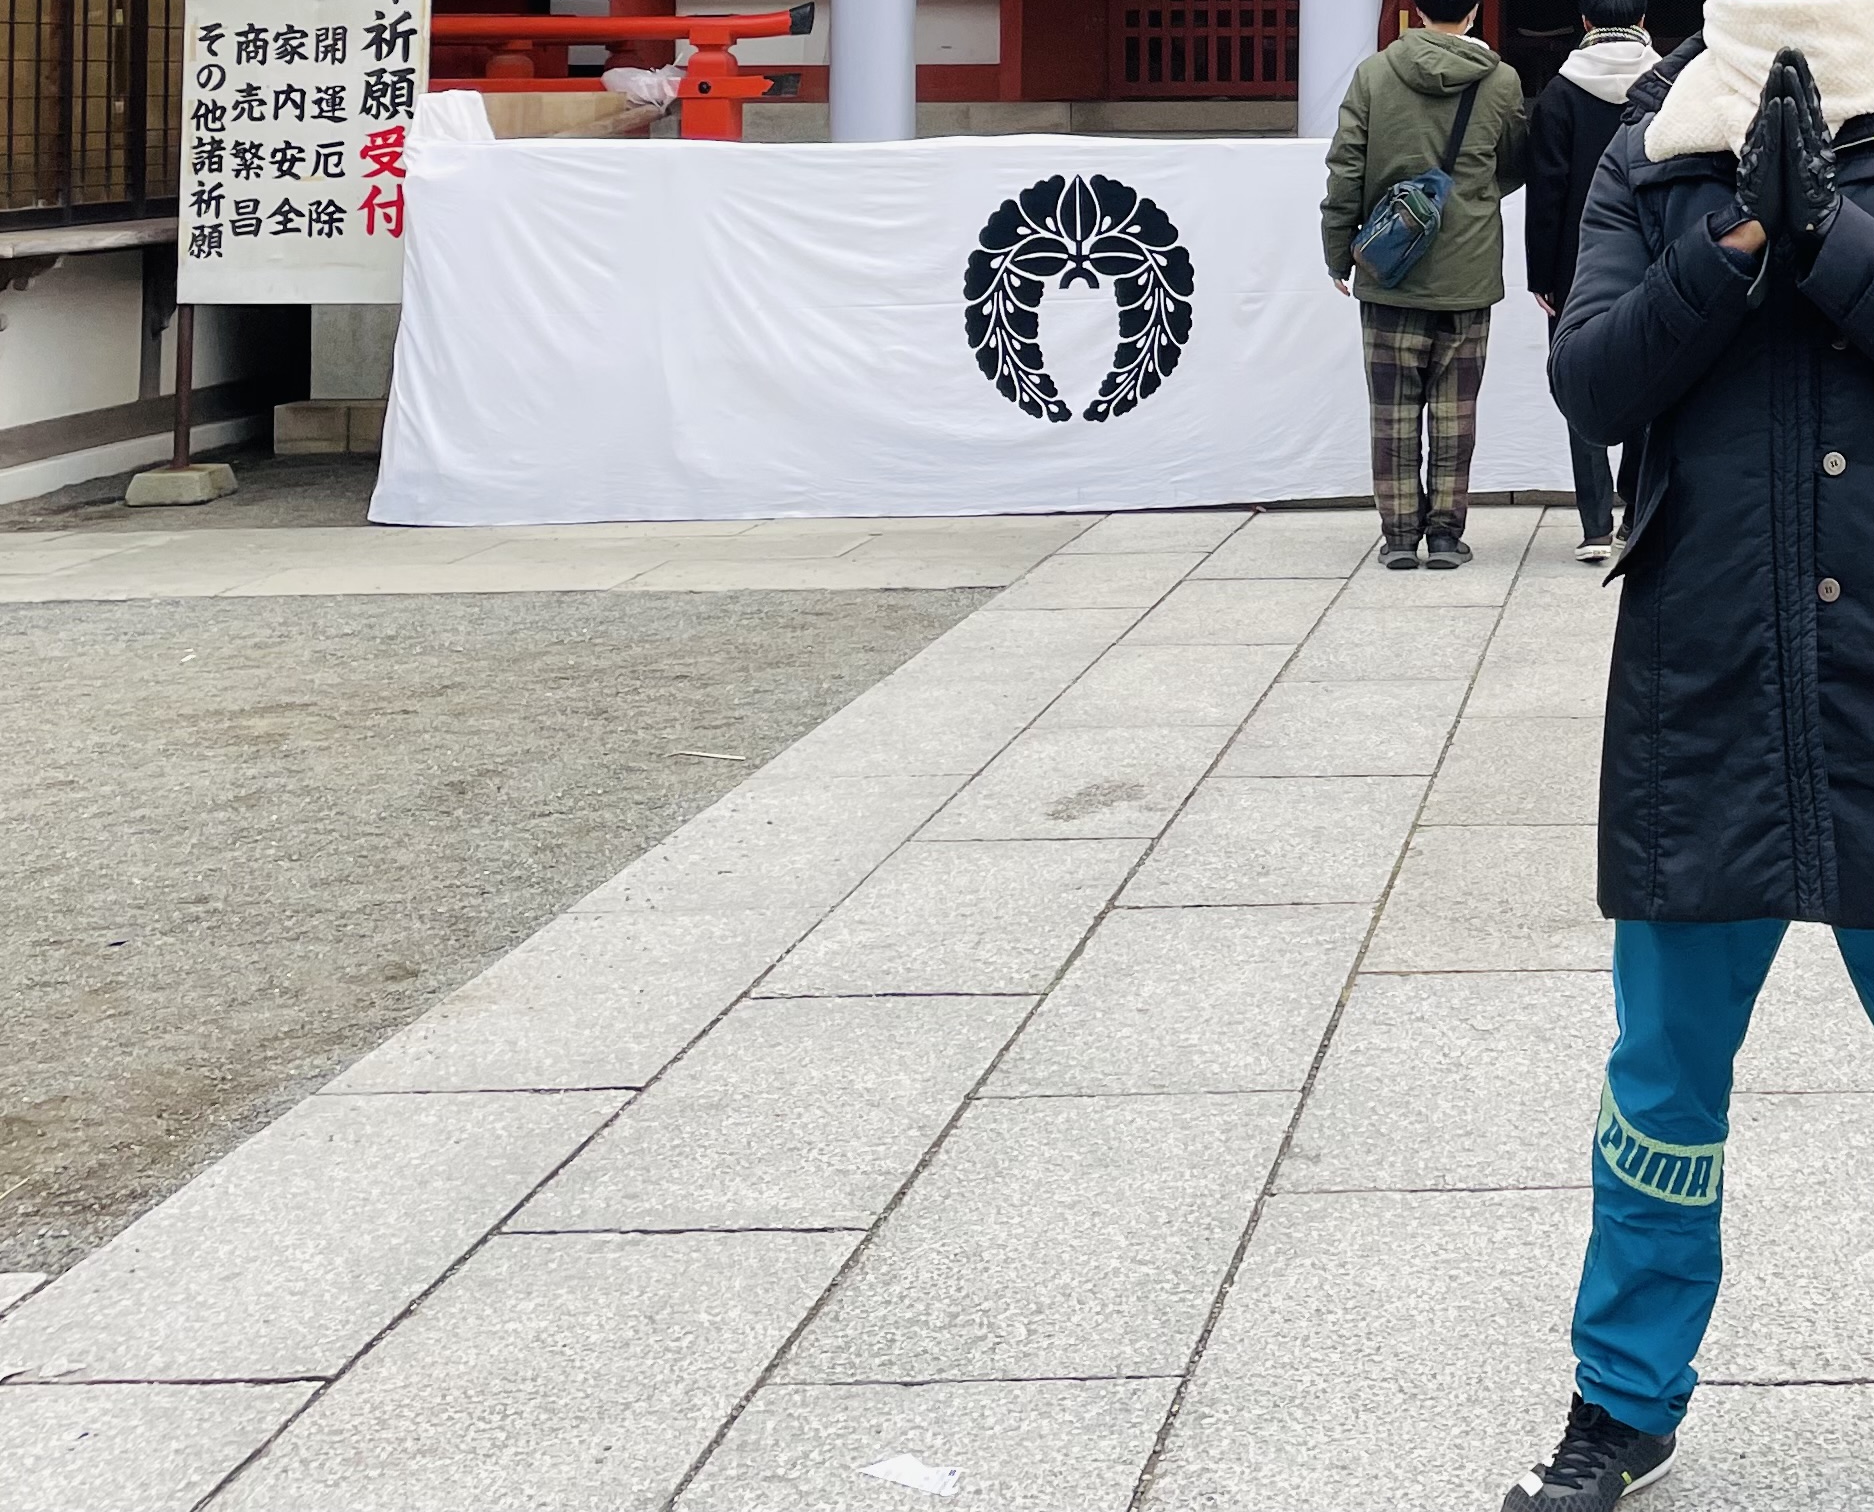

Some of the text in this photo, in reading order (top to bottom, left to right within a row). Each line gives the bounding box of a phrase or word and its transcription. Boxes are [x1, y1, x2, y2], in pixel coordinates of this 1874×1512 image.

[188, 23, 227, 259] その他諸祈願
[229, 23, 269, 238] 商売繁昌
[266, 23, 309, 236] 家内安全
[308, 25, 348, 238] 開運厄除
[1600, 1113, 1714, 1198] PUMA
